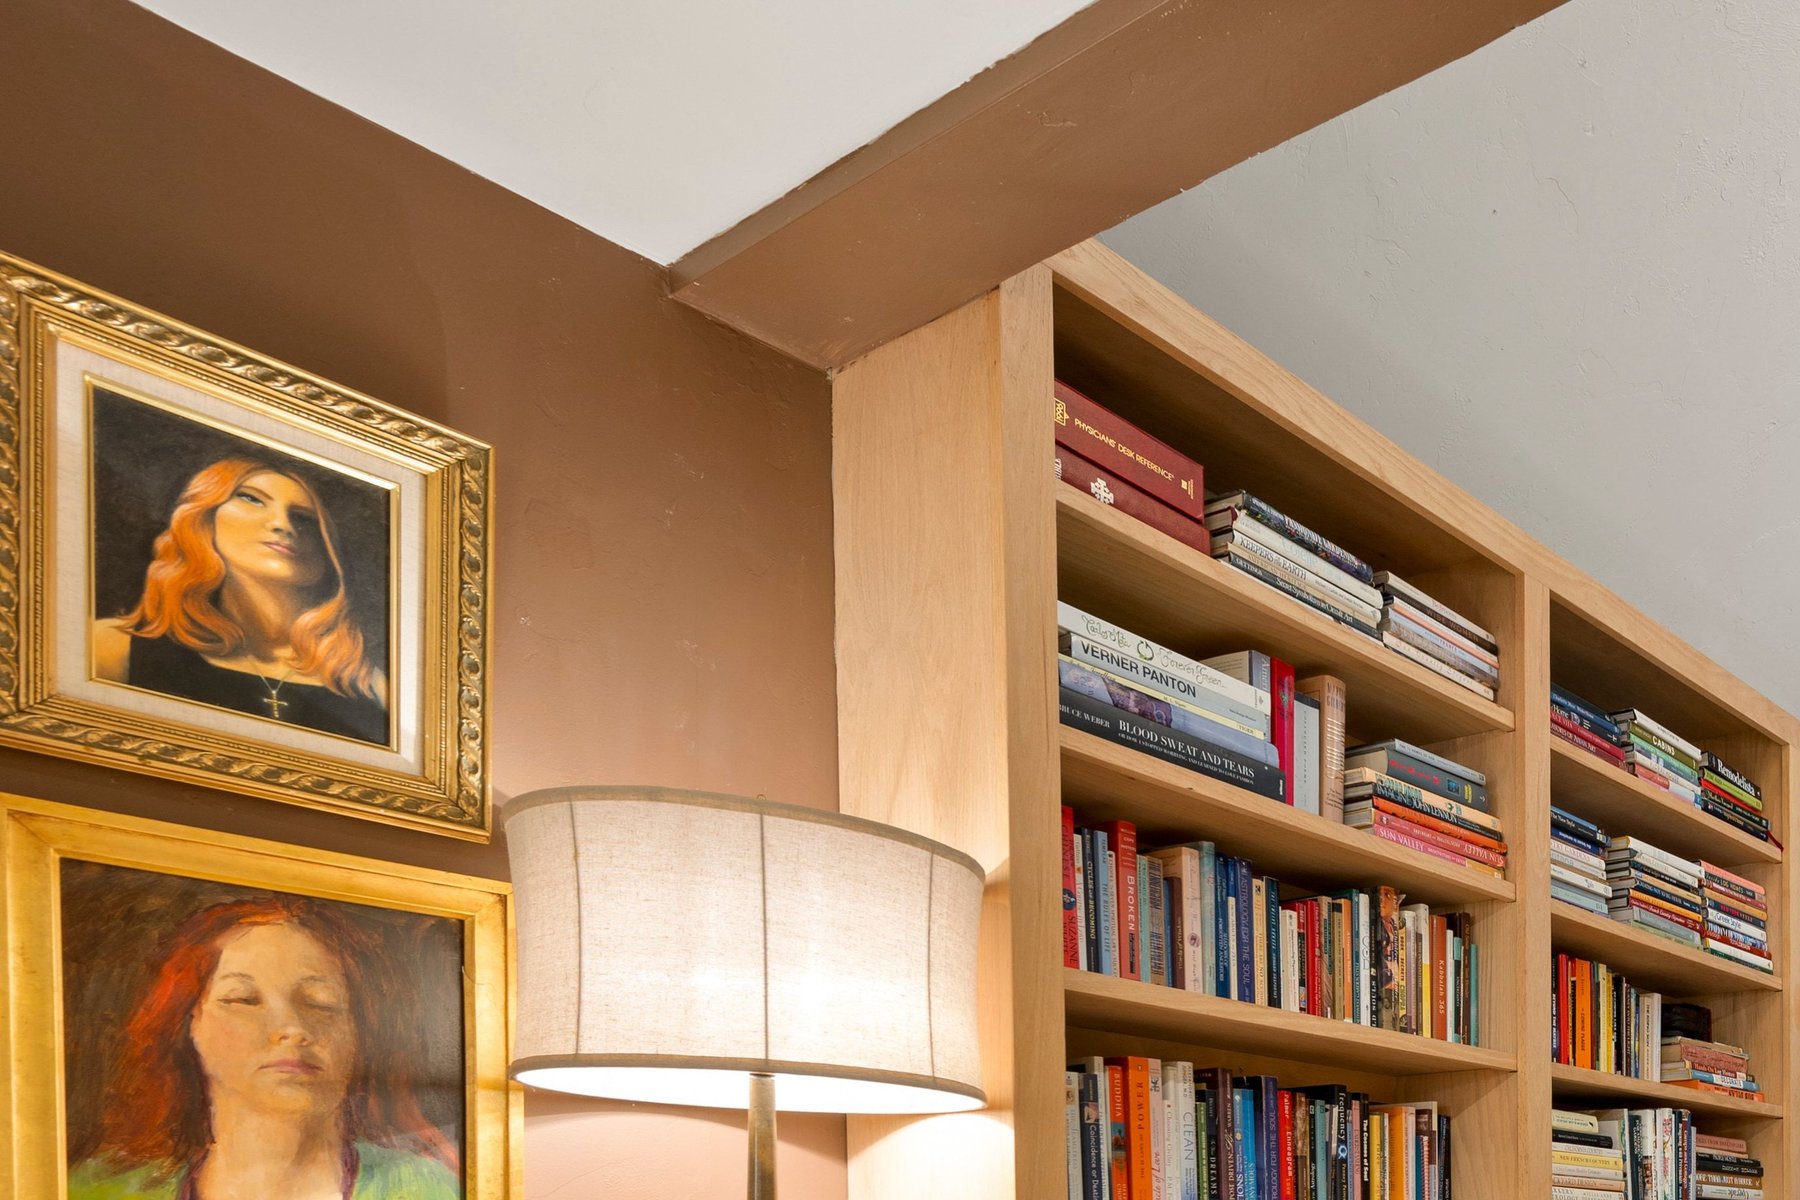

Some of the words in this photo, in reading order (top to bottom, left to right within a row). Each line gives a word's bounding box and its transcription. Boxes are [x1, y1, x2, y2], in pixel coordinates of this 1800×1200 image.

[1117, 443, 1135, 460] DESK
[1240, 536, 1275, 564] KEEPERS
[1281, 559, 1307, 580] EARTH
[1080, 640, 1139, 674] VERNER
[1142, 667, 1197, 698] PANTON
[1119, 720, 1159, 743] BLOOD
[1160, 735, 1198, 757] SWEAT
[1199, 750, 1221, 766] AND
[1222, 758, 1255, 778] TEARS
[1652, 735, 1676, 756] CABINS
[1717, 758, 1755, 797] Remodelista
[1426, 803, 1459, 824] LENNON
[1379, 827, 1397, 842] SUN
[1398, 834, 1425, 851] VALLEY
[1126, 875, 1135, 931] BROKEN
[1240, 878, 1249, 927] ASTROLOGY
[1241, 927, 1249, 941] FOR
[1242, 946, 1250, 961] THE
[1243, 964, 1251, 985] SOUL
[1113, 1073, 1122, 1118] BUDDHA
[1136, 1082, 1145, 1130] POWER
[1283, 1093, 1291, 1119] Palmer
[1269, 1110, 1277, 1131] SOUL
[1337, 1092, 1347, 1140] frequency
[1089, 1125, 1099, 1167] Coincidence
[1183, 1111, 1194, 1161] CLEAN
[1269, 1134, 1277, 1149] THE
[1091, 1169, 1098, 1178] or
[1151, 1151, 1164, 1173] Love
[1363, 1158, 1369, 1166] of
[1210, 1157, 1218, 1195] DREAMS
